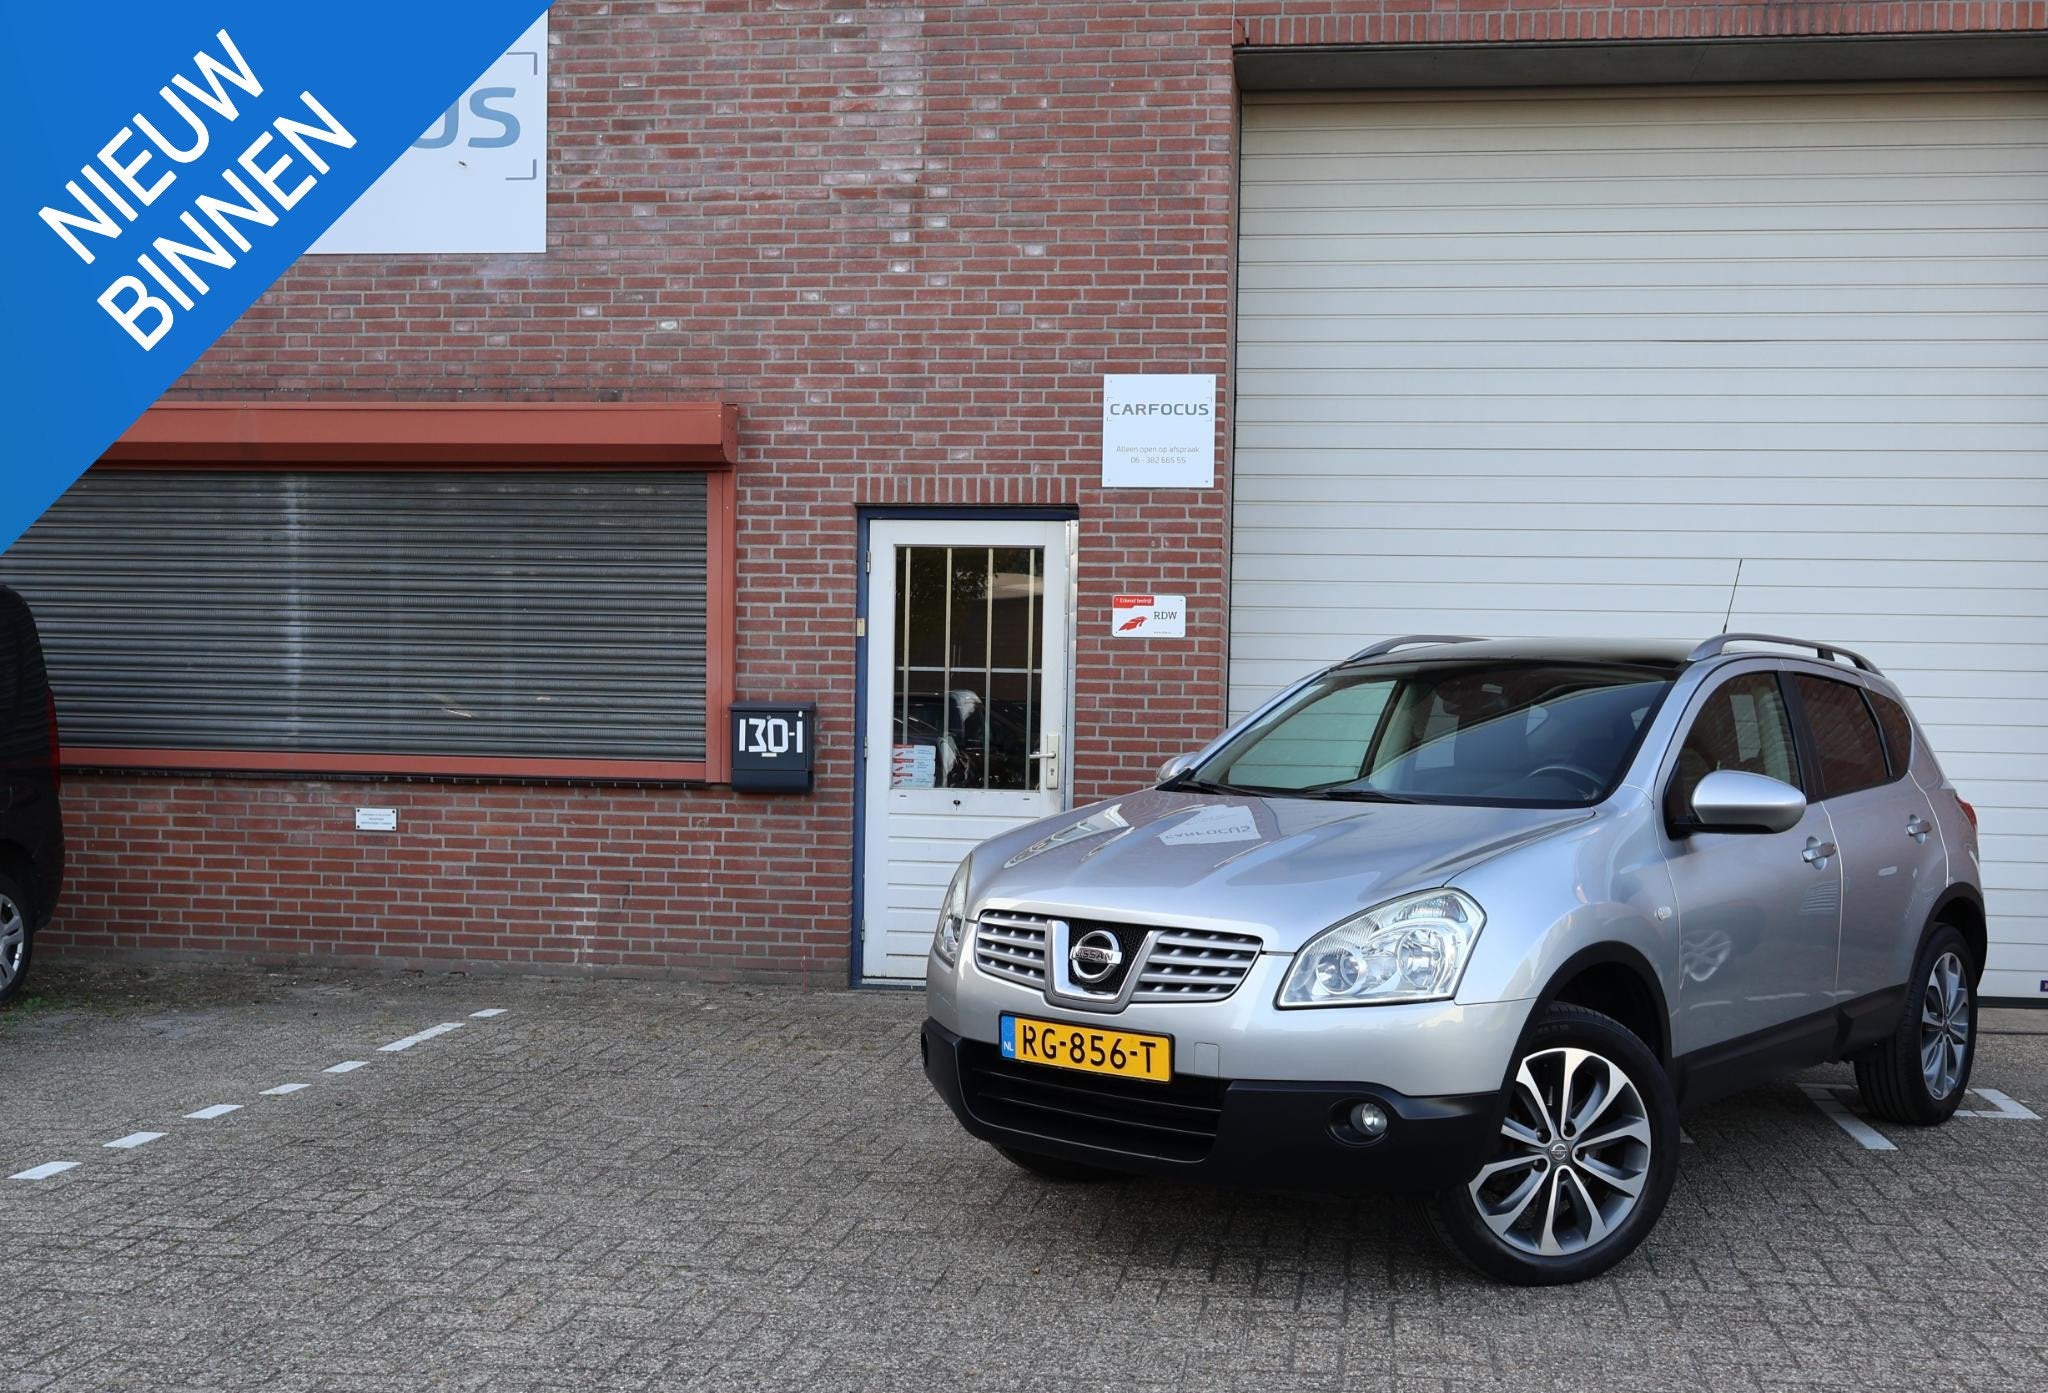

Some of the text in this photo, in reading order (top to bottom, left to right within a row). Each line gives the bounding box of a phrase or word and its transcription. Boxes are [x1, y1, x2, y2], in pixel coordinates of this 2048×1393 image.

[1110, 403, 1209, 416] CARFOCUS
[1116, 445, 1200, 454] Alleen open op afspraak
[1130, 456, 1140, 464] 06
[1147, 456, 1160, 464] 382
[1154, 611, 1178, 620] RDW
[1071, 948, 1113, 962] NISSAN
[1003, 1024, 1157, 1074] NL RG-856-T
